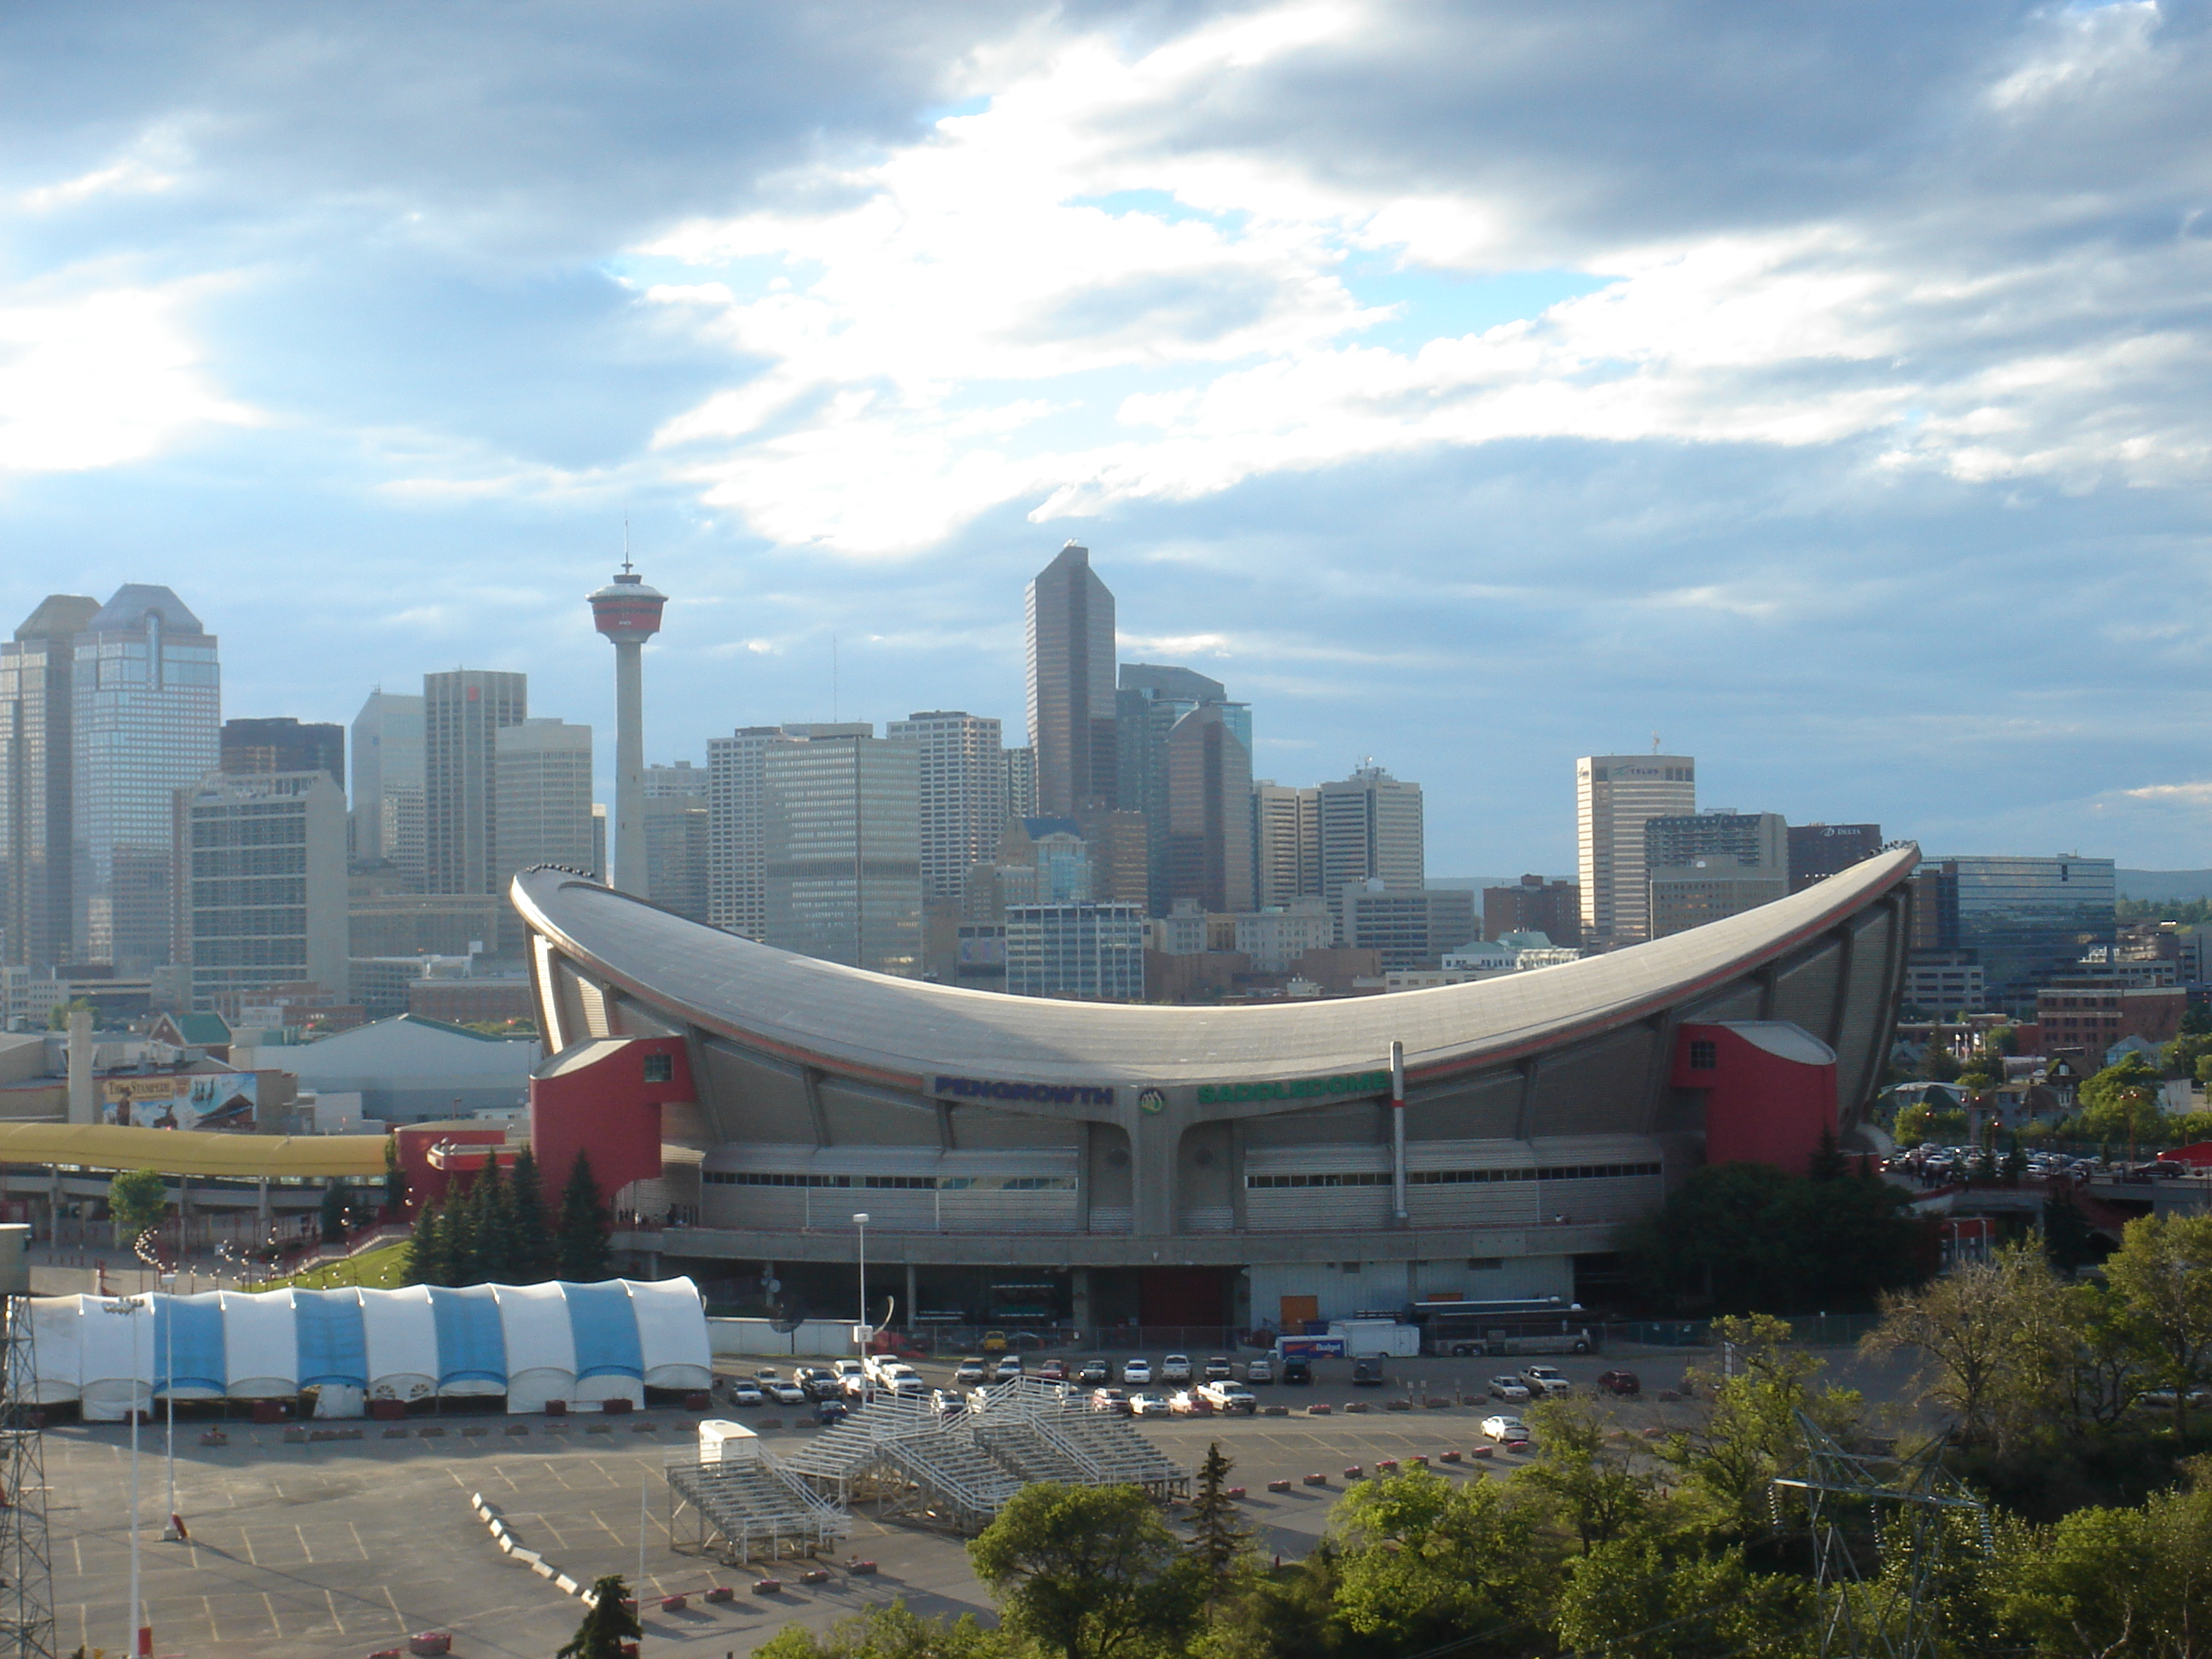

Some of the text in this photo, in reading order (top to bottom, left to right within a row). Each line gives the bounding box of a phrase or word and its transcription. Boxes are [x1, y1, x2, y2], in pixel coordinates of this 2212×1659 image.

[935, 1076, 1114, 1105] PENGROWTH
[1197, 1070, 1388, 1103] SADDLEDOME
[1316, 1342, 1341, 1353] Budget
